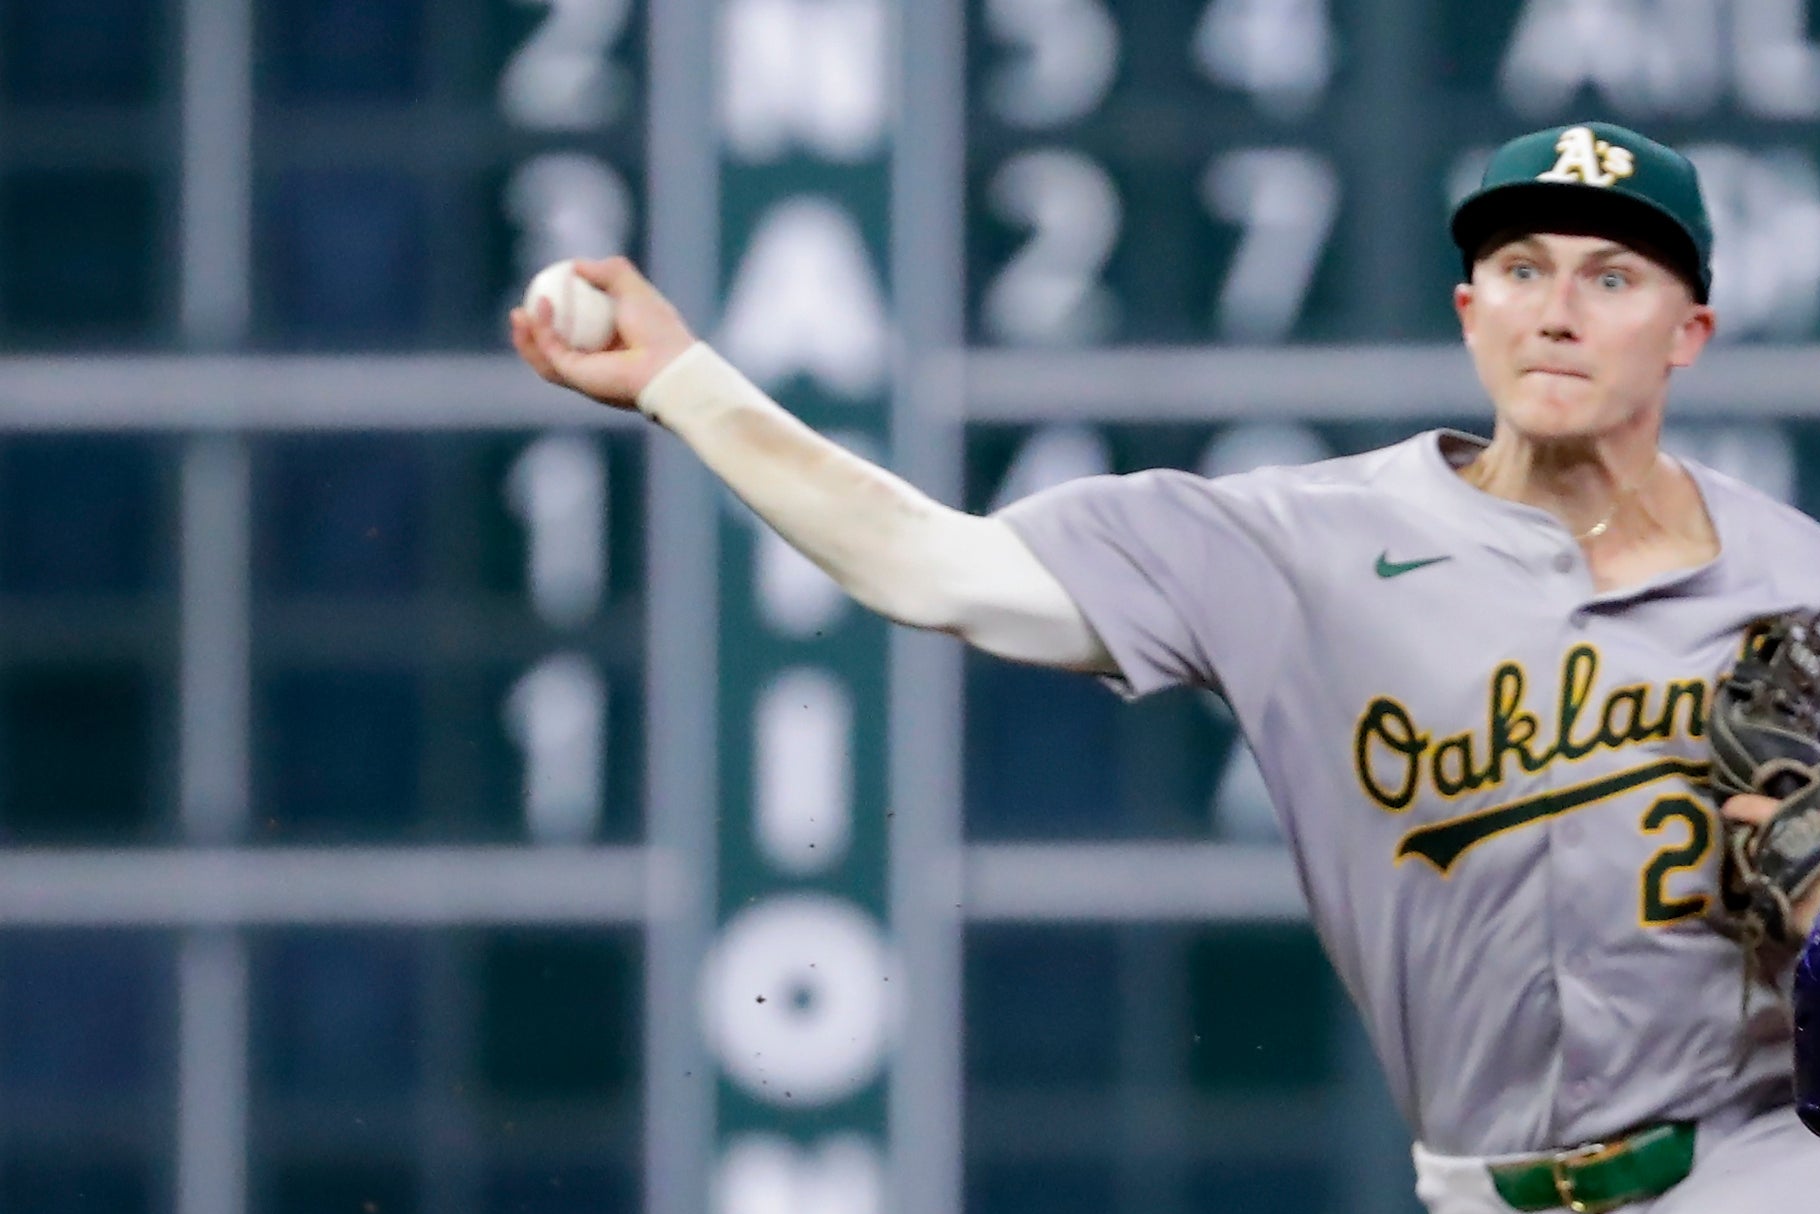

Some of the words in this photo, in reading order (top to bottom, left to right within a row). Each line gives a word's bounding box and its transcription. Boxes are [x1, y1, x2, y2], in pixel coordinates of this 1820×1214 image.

[984, 148, 1122, 343] 2
[1200, 145, 1338, 343] 7
[1535, 126, 1634, 187] A's
[1351, 636, 1722, 812] Oaklan
